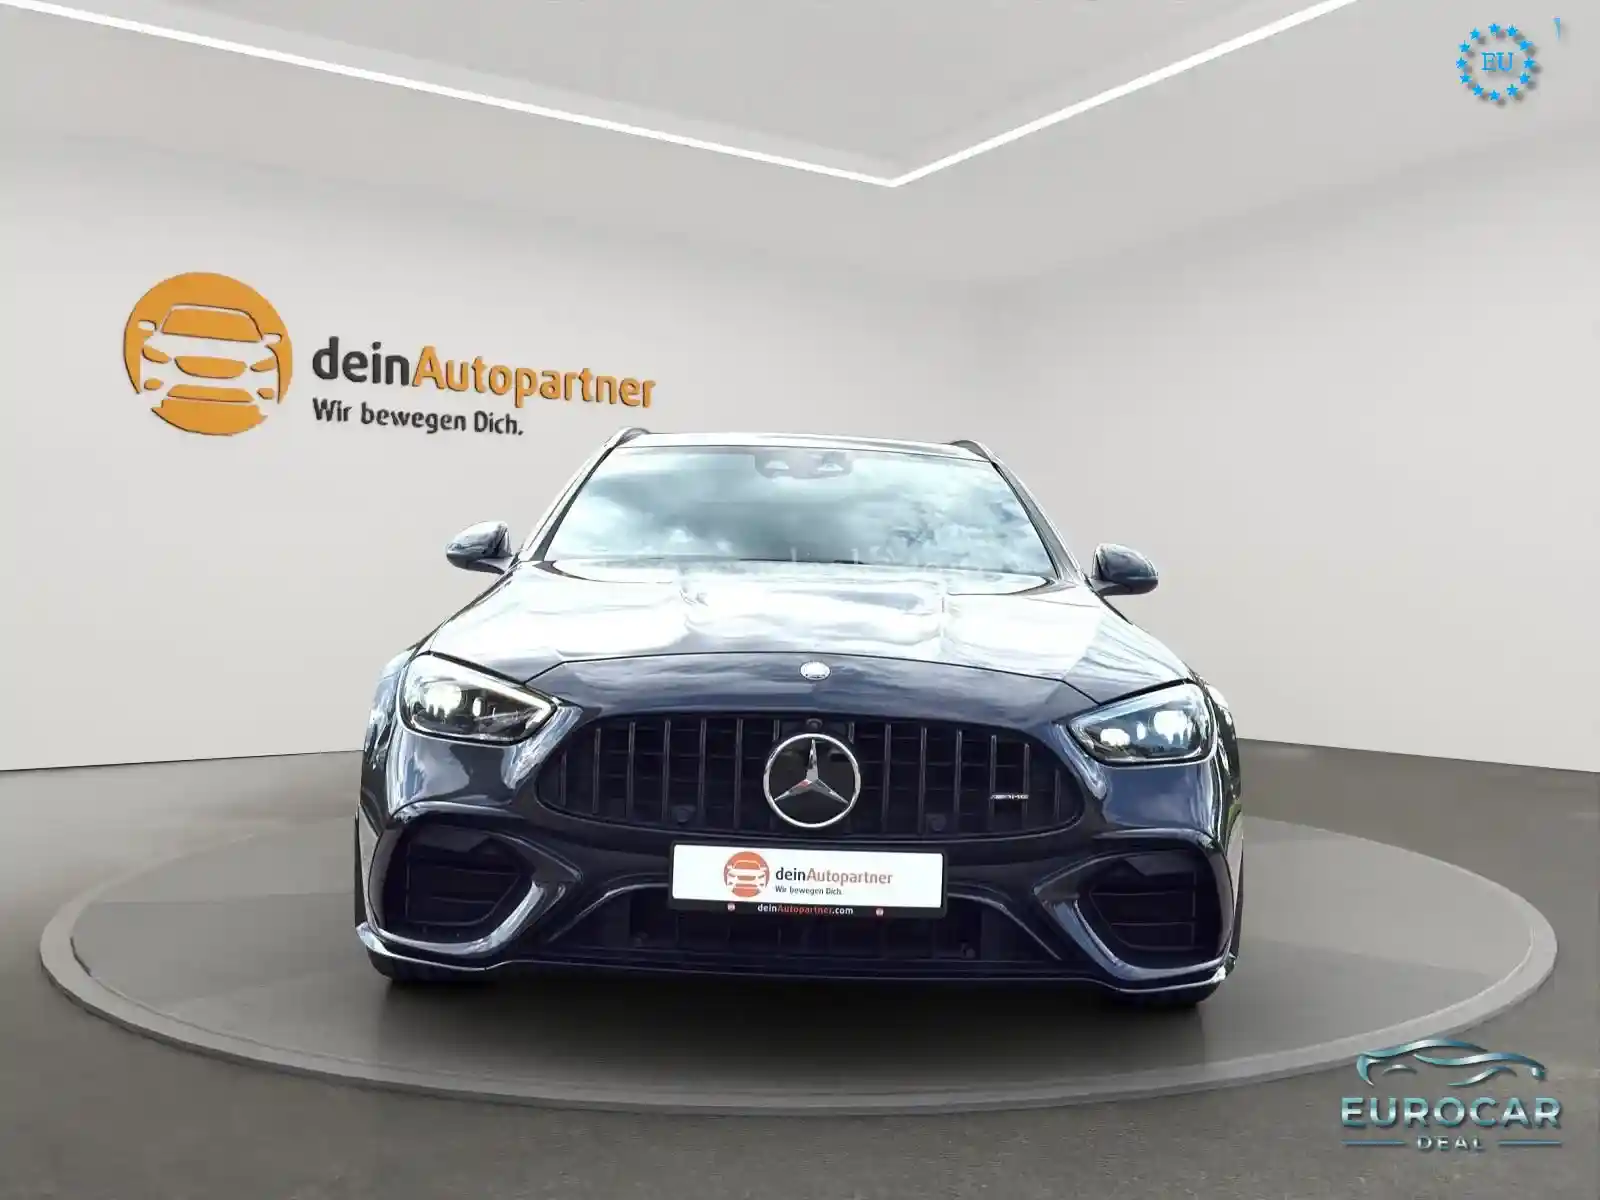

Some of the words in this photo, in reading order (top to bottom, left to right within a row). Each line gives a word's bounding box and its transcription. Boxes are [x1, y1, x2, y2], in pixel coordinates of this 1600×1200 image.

[312, 335, 656, 408] deinAutopartner
[313, 397, 352, 424] Wir
[360, 406, 467, 433] bewegen
[473, 411, 524, 436] Dich.
[775, 867, 893, 886] deinAutopartner
[775, 885, 787, 893] Wir
[789, 886, 824, 896] bewegen
[757, 903, 854, 916] deinAutopartner.com
